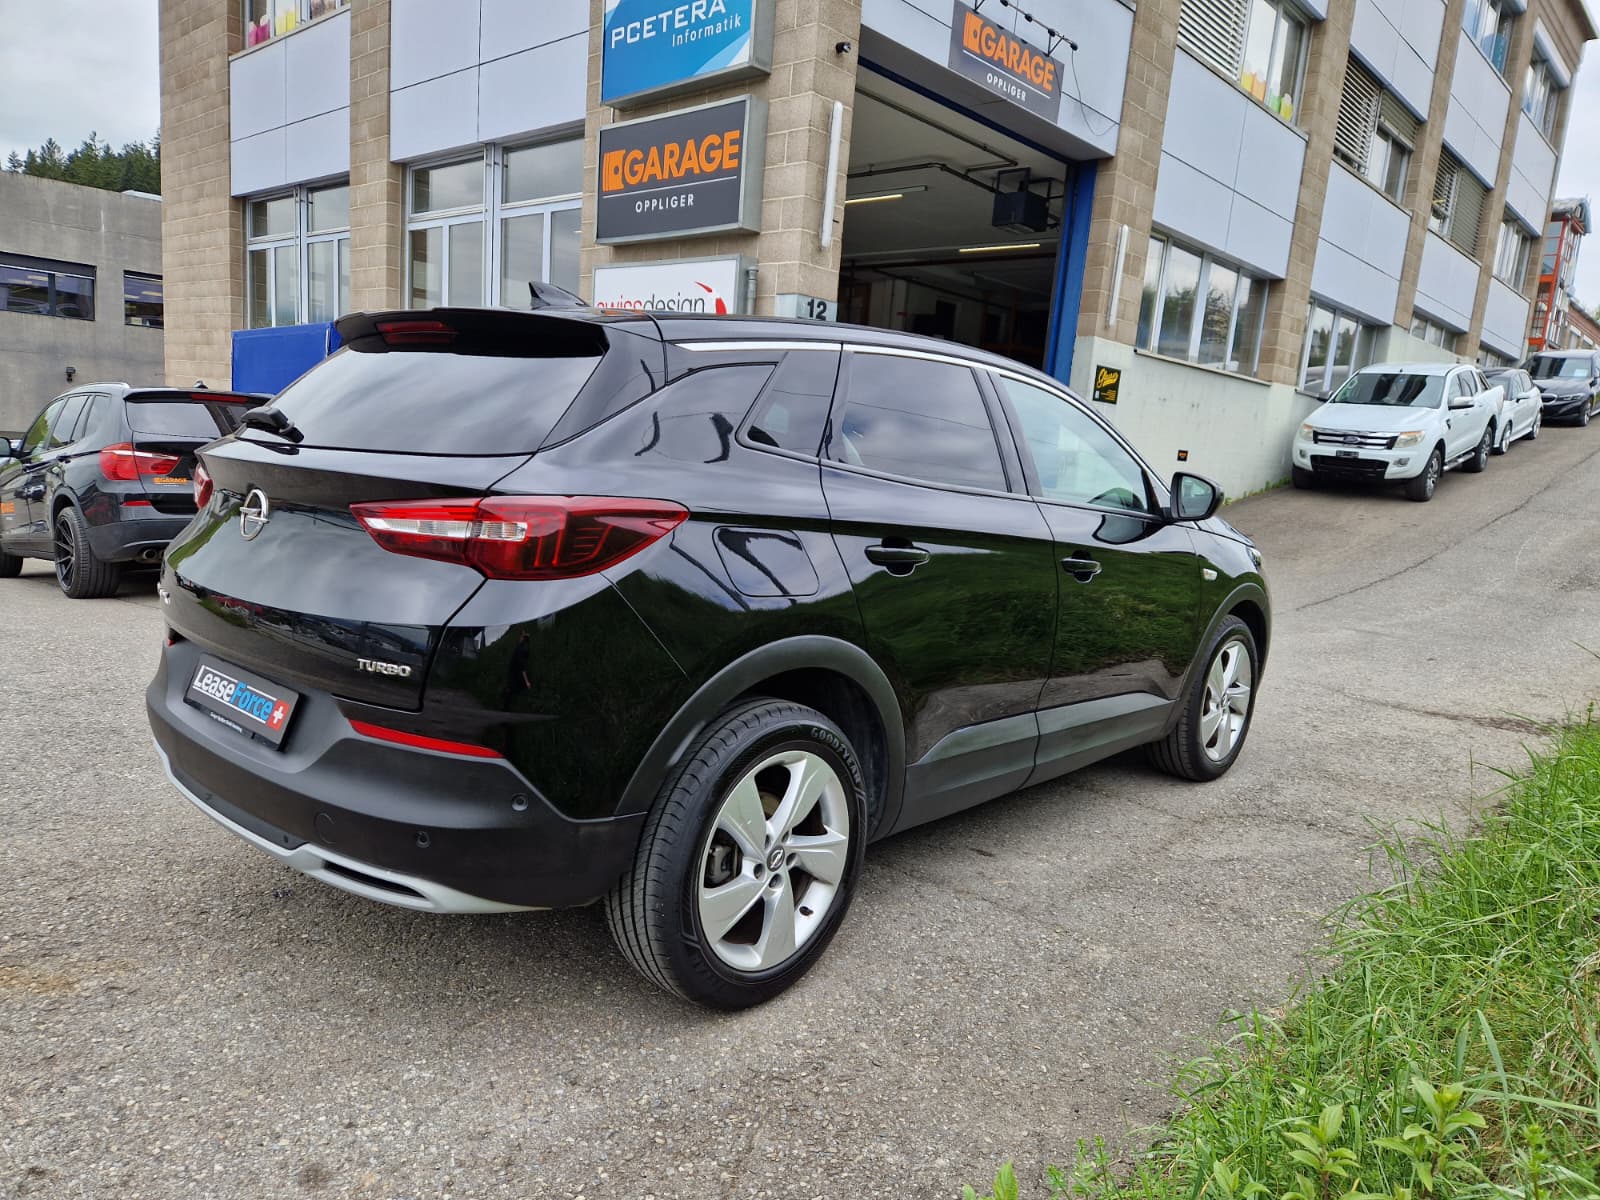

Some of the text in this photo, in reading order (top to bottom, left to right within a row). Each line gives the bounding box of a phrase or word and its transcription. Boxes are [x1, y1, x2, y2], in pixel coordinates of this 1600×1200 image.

[611, 0, 726, 48] PCETERA
[672, 13, 741, 47] Informatik
[980, 26, 1055, 92] GARAGE
[986, 73, 1026, 101] OPPLIGER
[624, 130, 740, 185] GARAGE
[635, 193, 695, 213] OPPLIGER
[807, 298, 827, 321] 12
[357, 658, 411, 677] TURBO
[193, 664, 274, 721] LeaseForce
